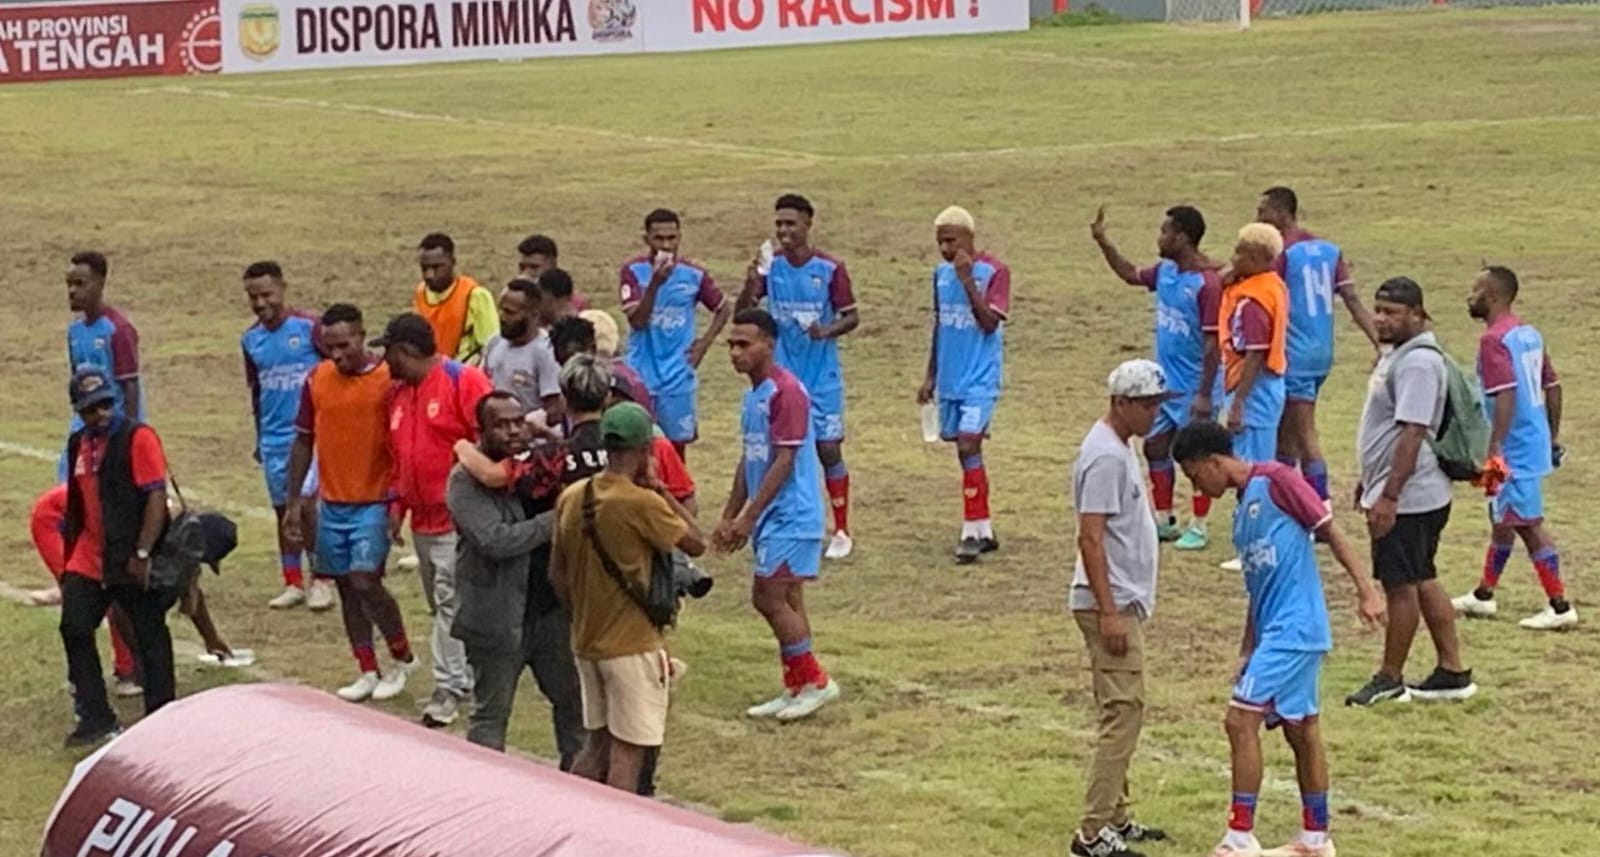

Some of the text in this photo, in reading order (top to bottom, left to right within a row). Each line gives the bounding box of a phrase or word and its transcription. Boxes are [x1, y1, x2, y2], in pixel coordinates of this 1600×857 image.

[27, 15, 128, 38] PROVINSI
[295, 0, 577, 53] DISPORA MIMIKA
[692, 0, 764, 32] NO
[13, 34, 165, 72] TENGAH
[1303, 261, 1333, 317] 14
[76, 797, 236, 857] PIA
